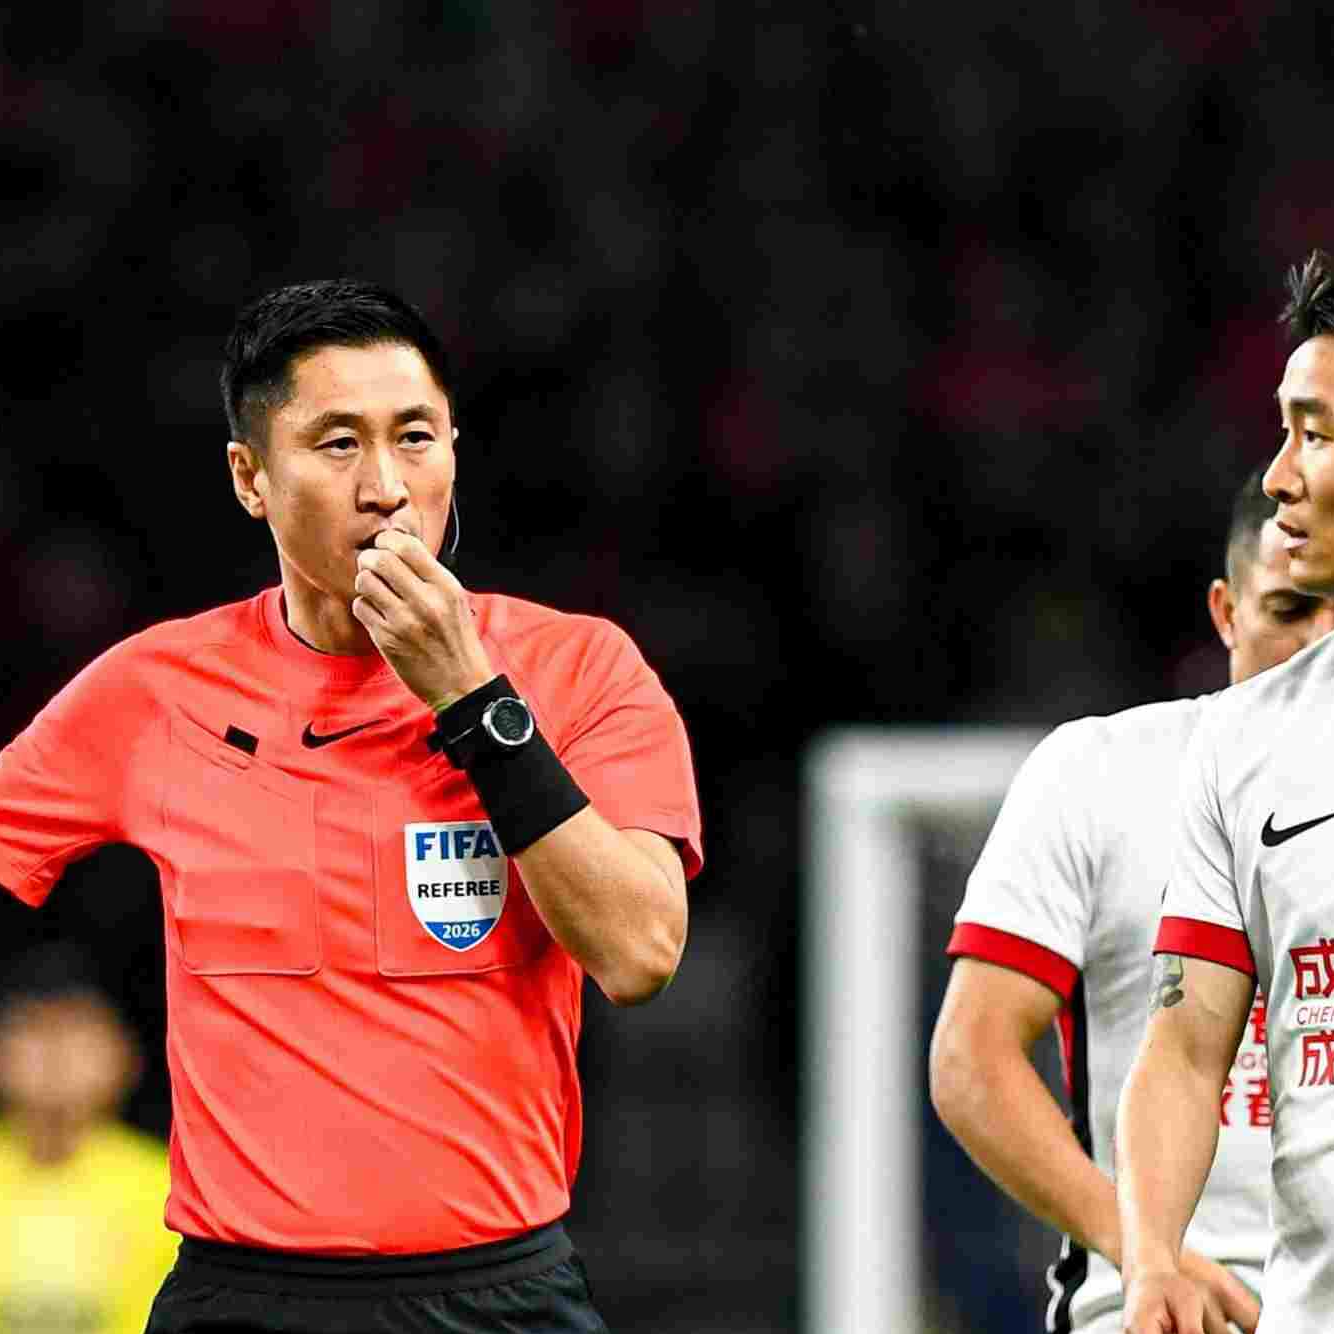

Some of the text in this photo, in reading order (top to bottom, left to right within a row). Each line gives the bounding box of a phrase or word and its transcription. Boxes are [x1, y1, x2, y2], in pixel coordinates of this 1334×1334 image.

[415, 829, 500, 861] FIFA
[417, 879, 501, 899] REFEREE
[442, 922, 481, 939] 2026
